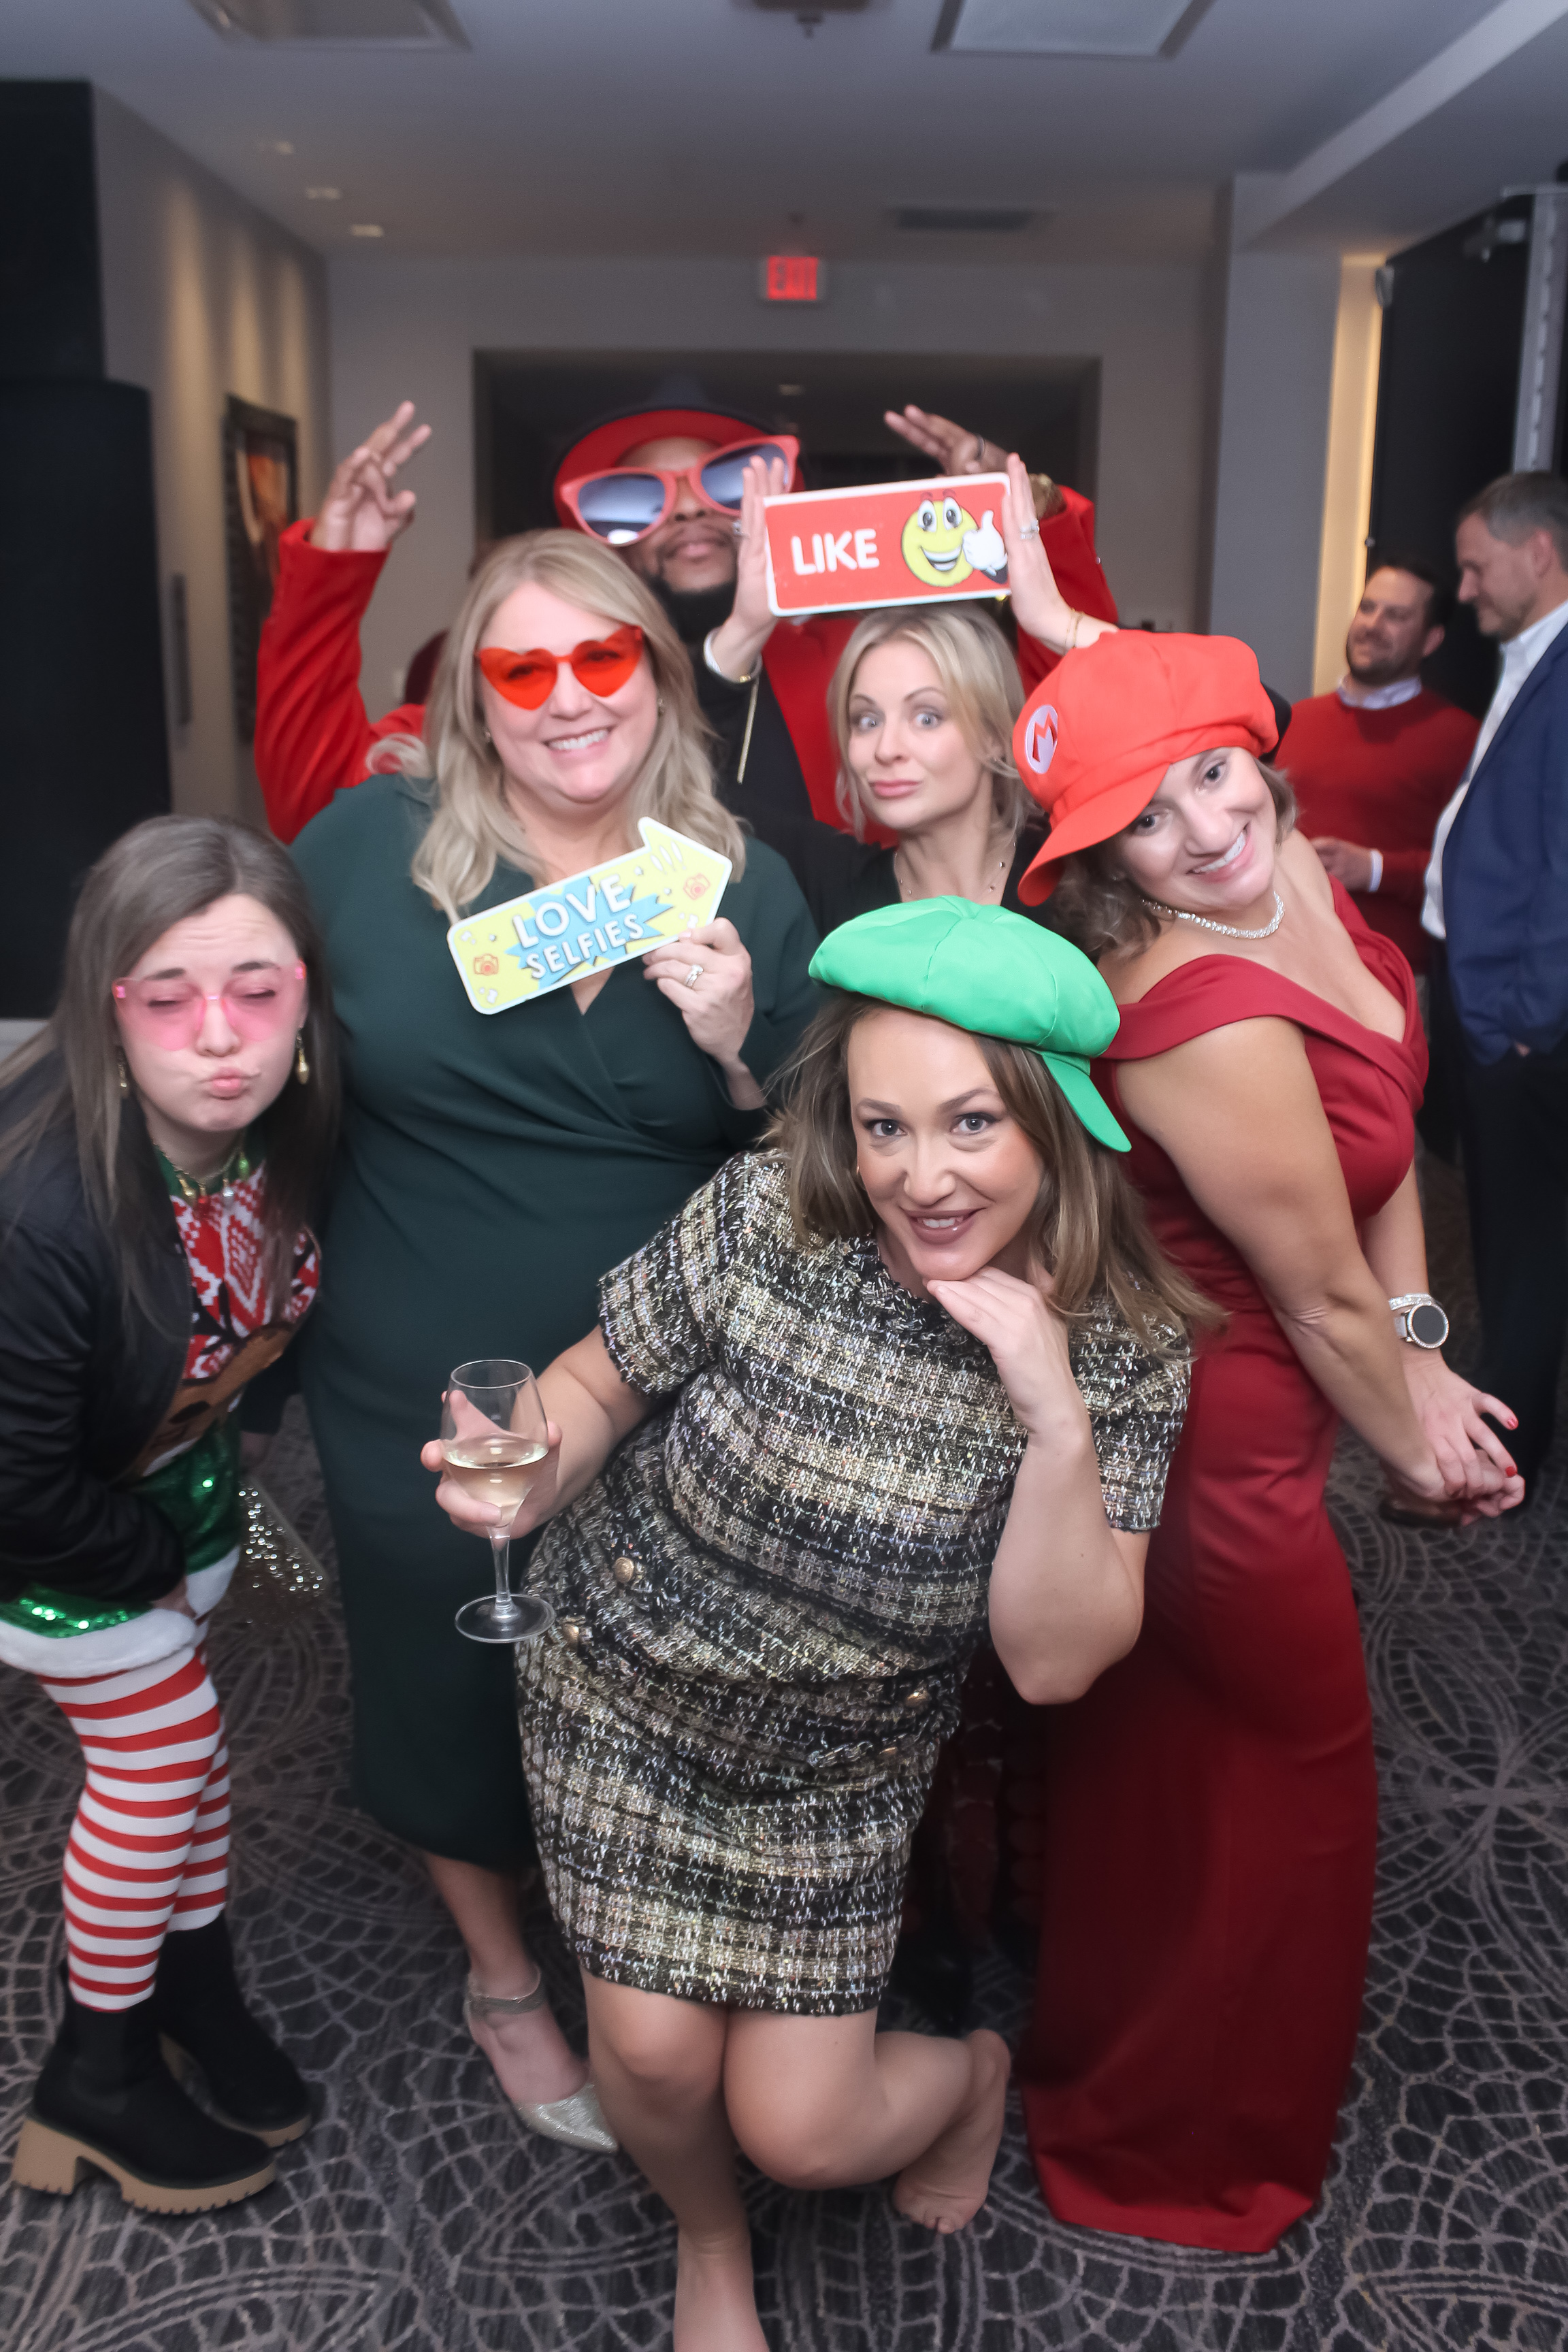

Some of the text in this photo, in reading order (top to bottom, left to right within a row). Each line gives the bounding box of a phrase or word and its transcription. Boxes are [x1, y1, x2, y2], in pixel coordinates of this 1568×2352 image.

[791, 528, 880, 576] LIKE
[1032, 709, 1058, 763] M
[512, 874, 632, 949] LOVE
[525, 913, 644, 979] SELFIES
